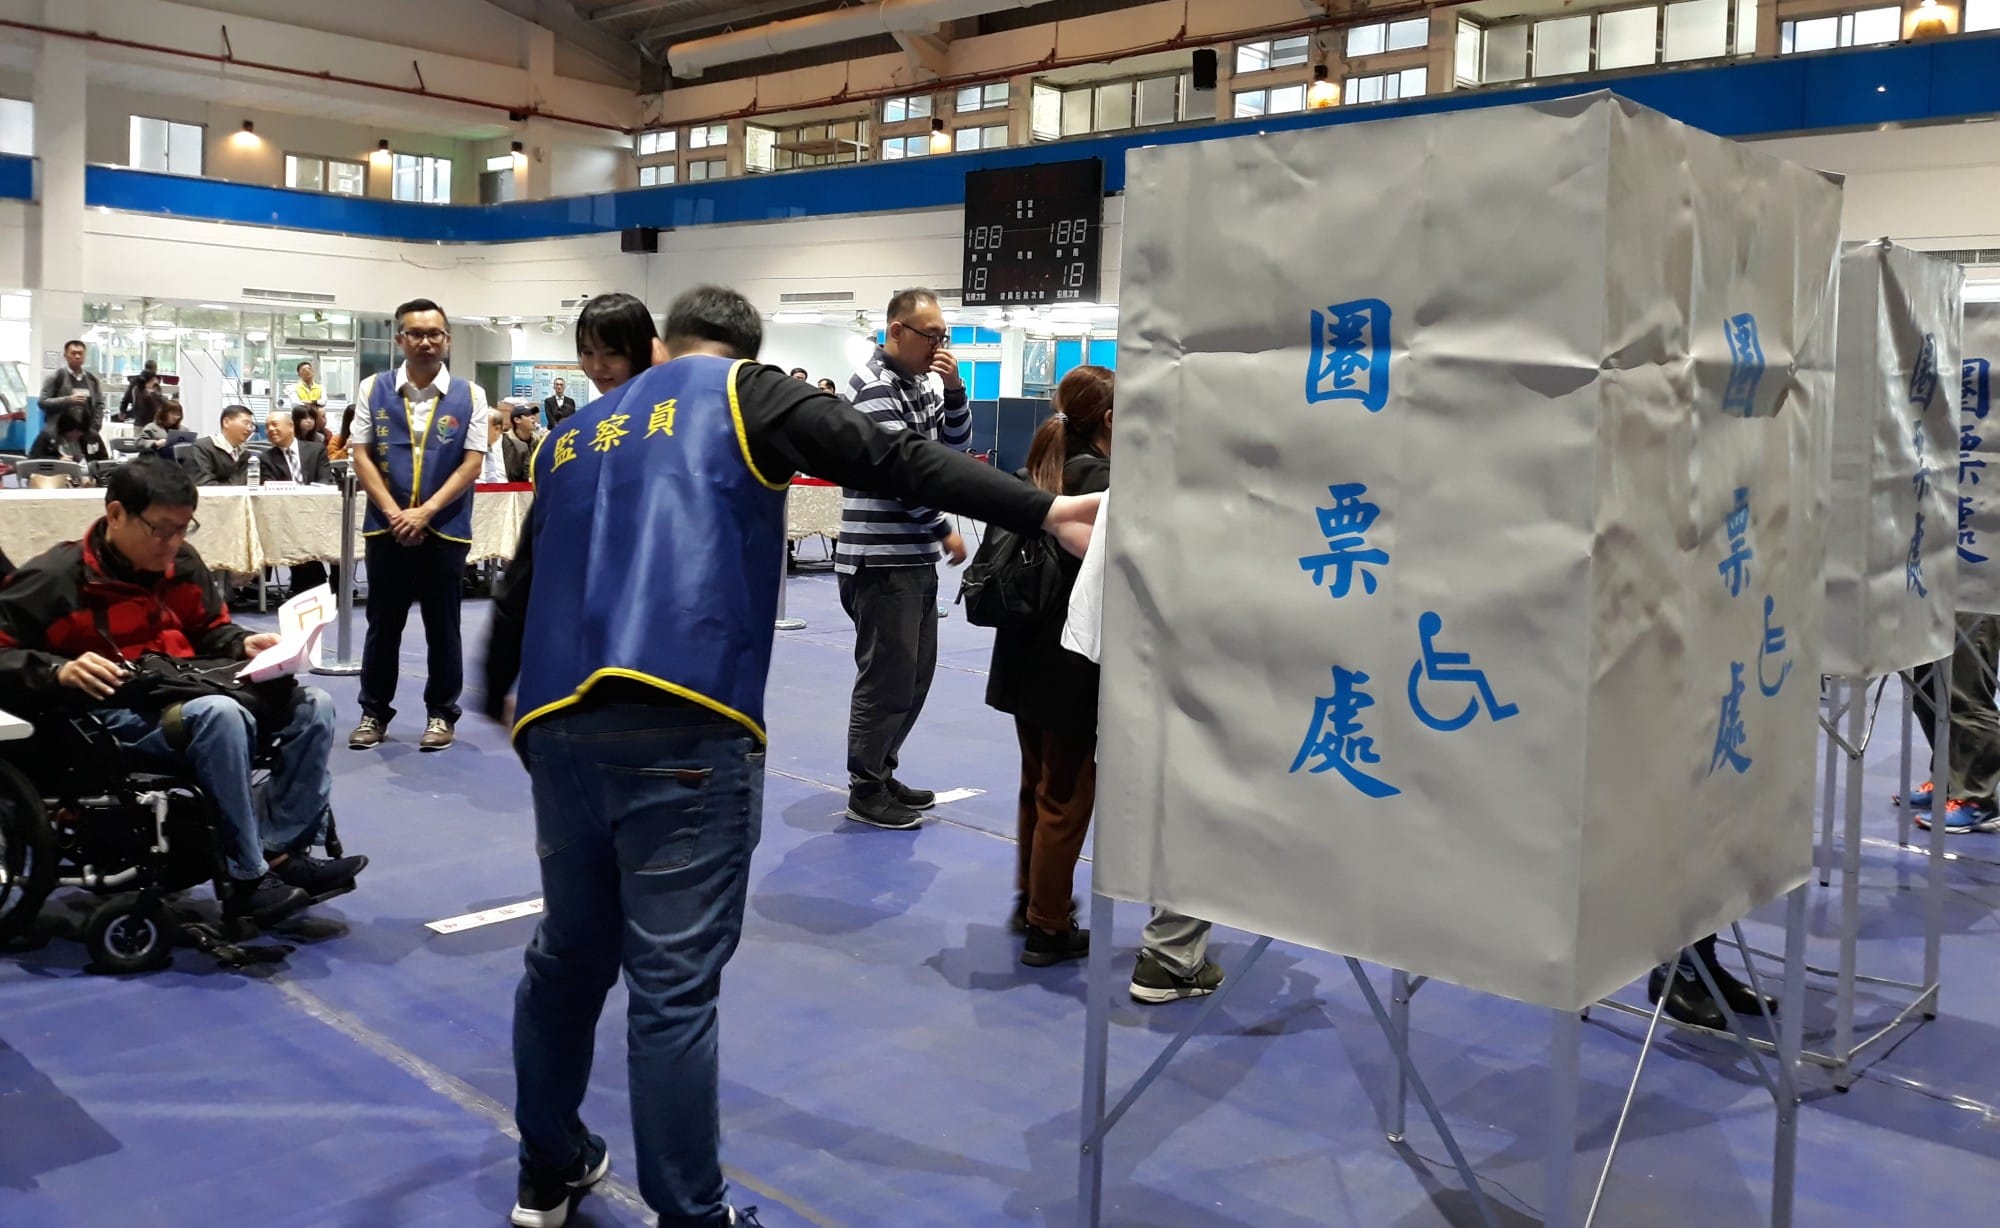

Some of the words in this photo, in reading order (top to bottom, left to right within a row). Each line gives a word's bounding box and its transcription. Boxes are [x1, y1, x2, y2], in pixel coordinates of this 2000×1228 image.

[550, 398, 678, 473] 監察員
[1288, 298, 1402, 798] 圈票處
[1707, 312, 1764, 778] 圈票處
